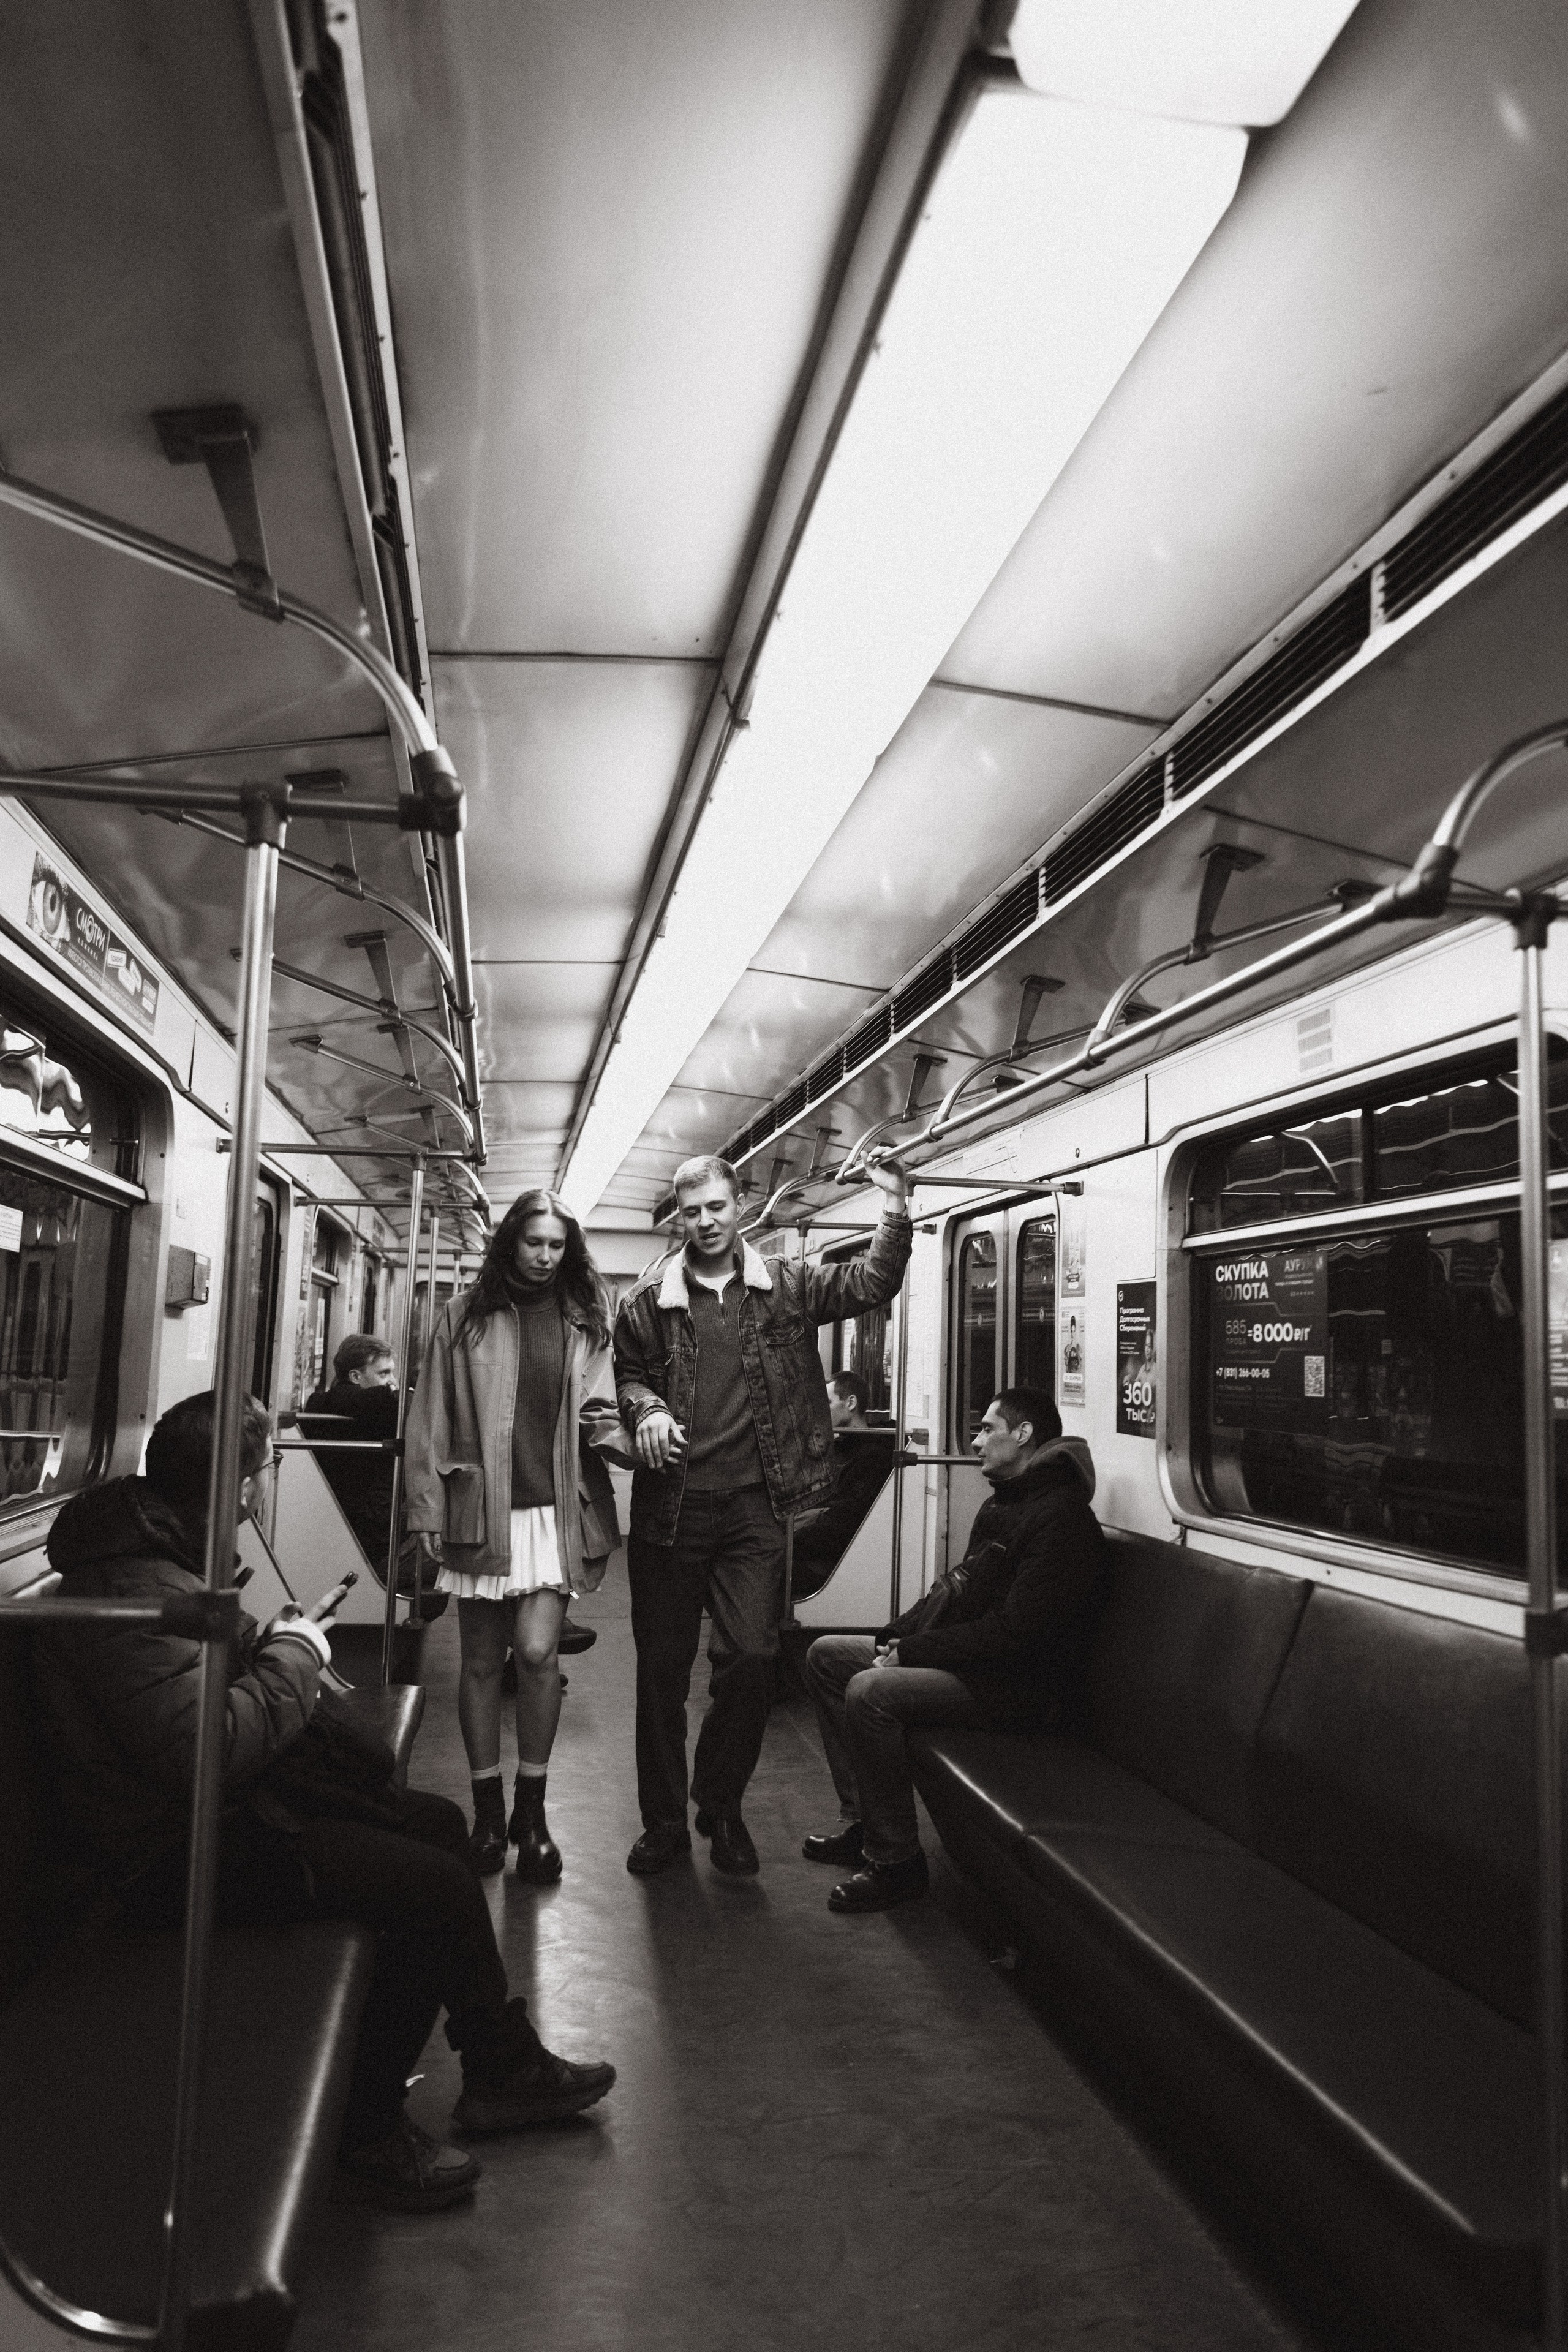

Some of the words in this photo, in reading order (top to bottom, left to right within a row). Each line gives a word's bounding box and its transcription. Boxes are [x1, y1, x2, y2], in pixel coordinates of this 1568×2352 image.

[77, 908, 106, 952] СМОТРИ
[1215, 1261, 1269, 1283] СКУПКА
[1226, 1319, 1246, 1334] 585
[1123, 1381, 1152, 1406] 360
